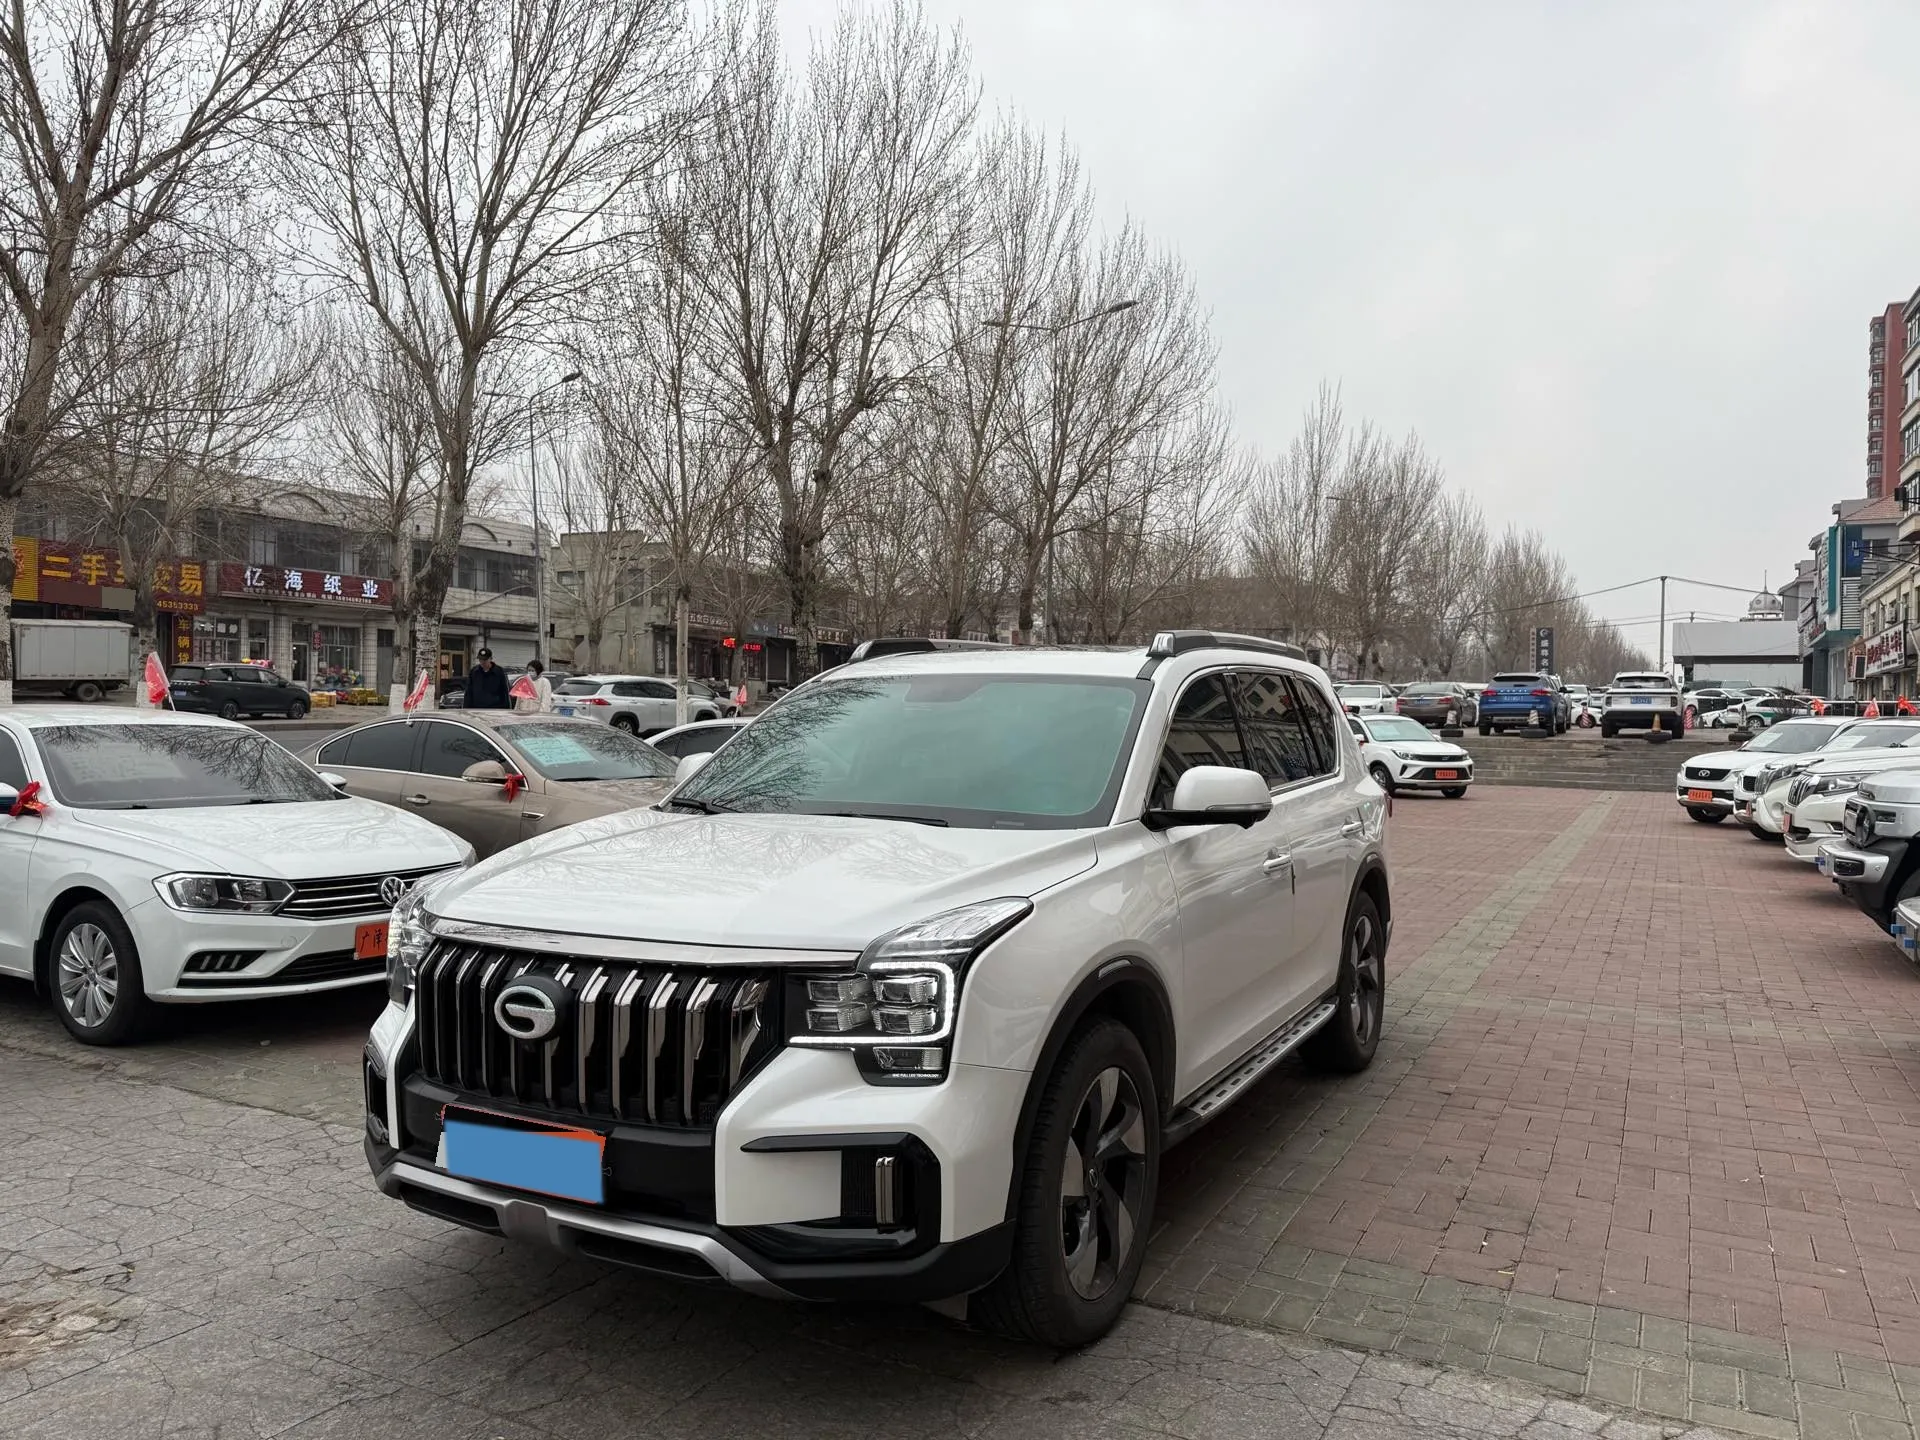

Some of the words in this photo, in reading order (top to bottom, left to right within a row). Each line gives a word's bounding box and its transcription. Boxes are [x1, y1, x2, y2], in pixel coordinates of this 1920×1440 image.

[243, 565, 379, 599] 亿海纸业
[360, 928, 388, 952] 广泽
